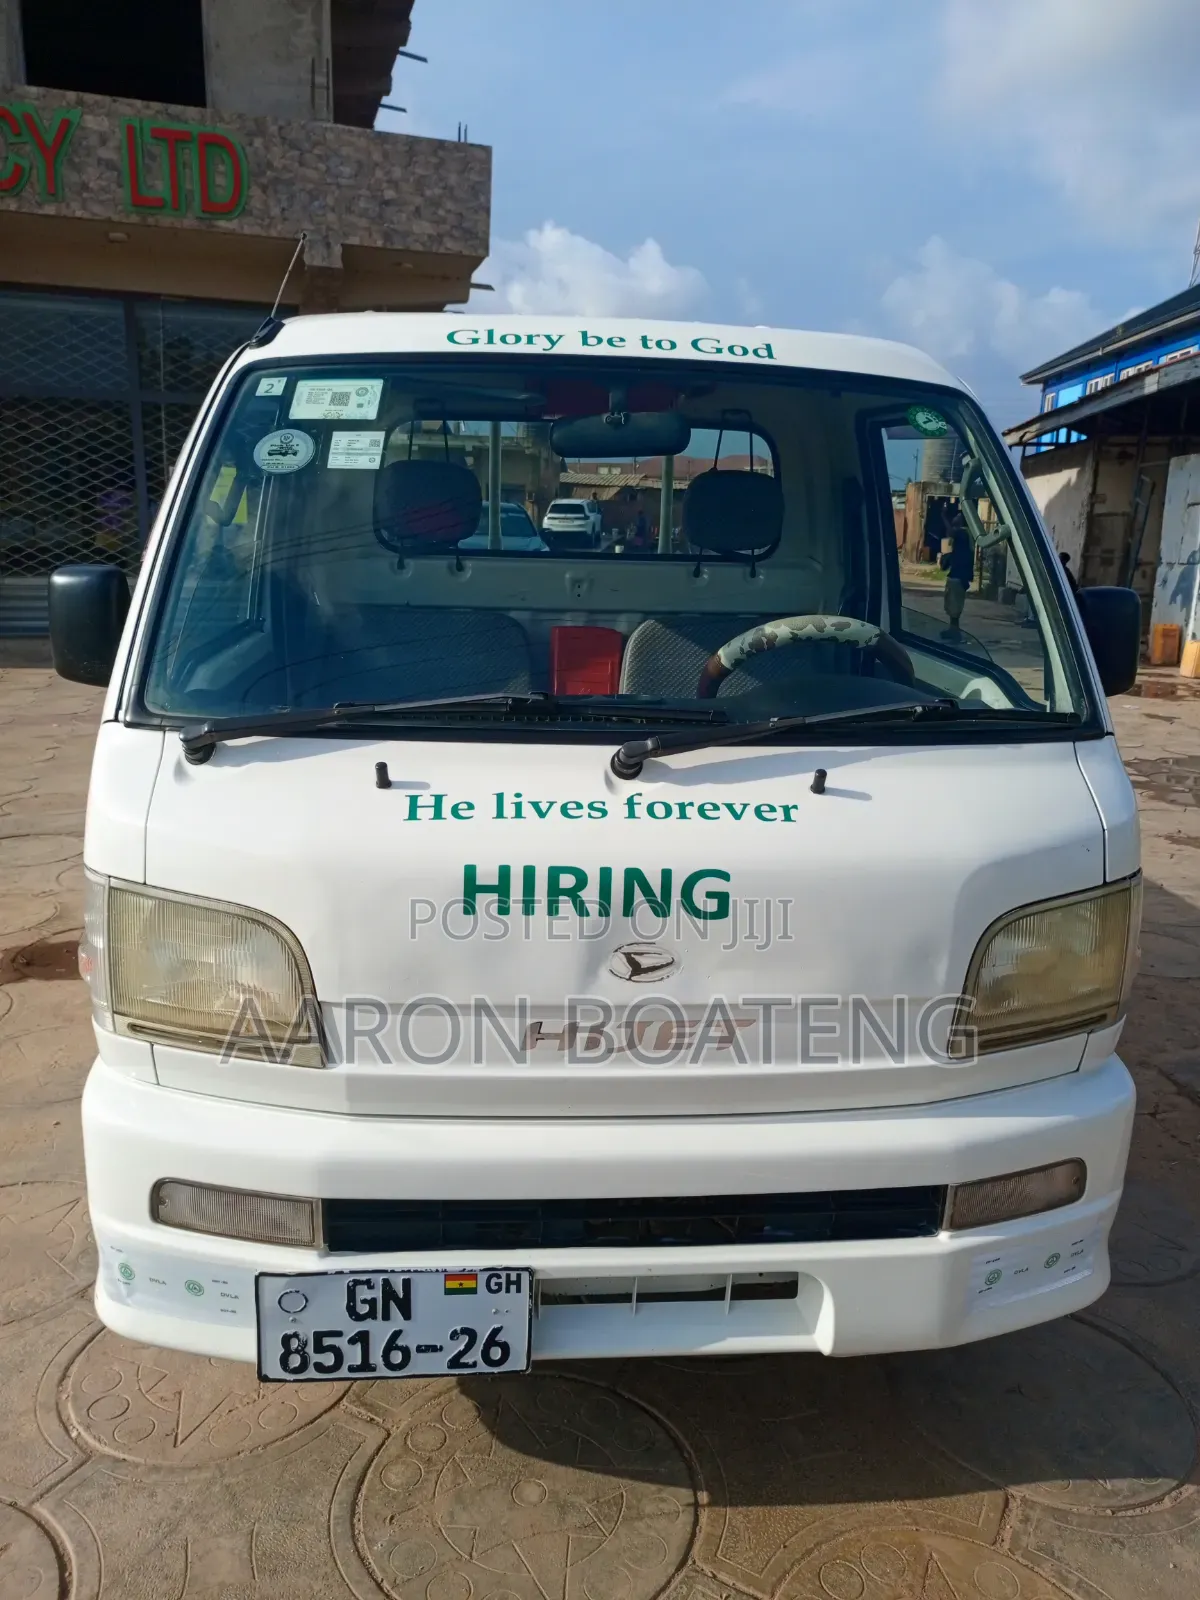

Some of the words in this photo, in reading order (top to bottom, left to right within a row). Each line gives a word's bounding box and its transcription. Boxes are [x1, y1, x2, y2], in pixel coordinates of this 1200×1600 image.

[121, 117, 249, 219] LTD
[446, 328, 566, 351] Glory
[578, 330, 627, 349] be
[638, 334, 678, 351] to
[690, 337, 778, 361] God
[263, 383, 274, 393] 2
[402, 793, 475, 822] He
[491, 791, 609, 821] lives
[622, 792, 800, 823] forever
[462, 863, 732, 921] HIRING
[345, 1277, 412, 1322] GN
[485, 1272, 522, 1295] GH
[279, 1325, 511, 1375] 8516-26
